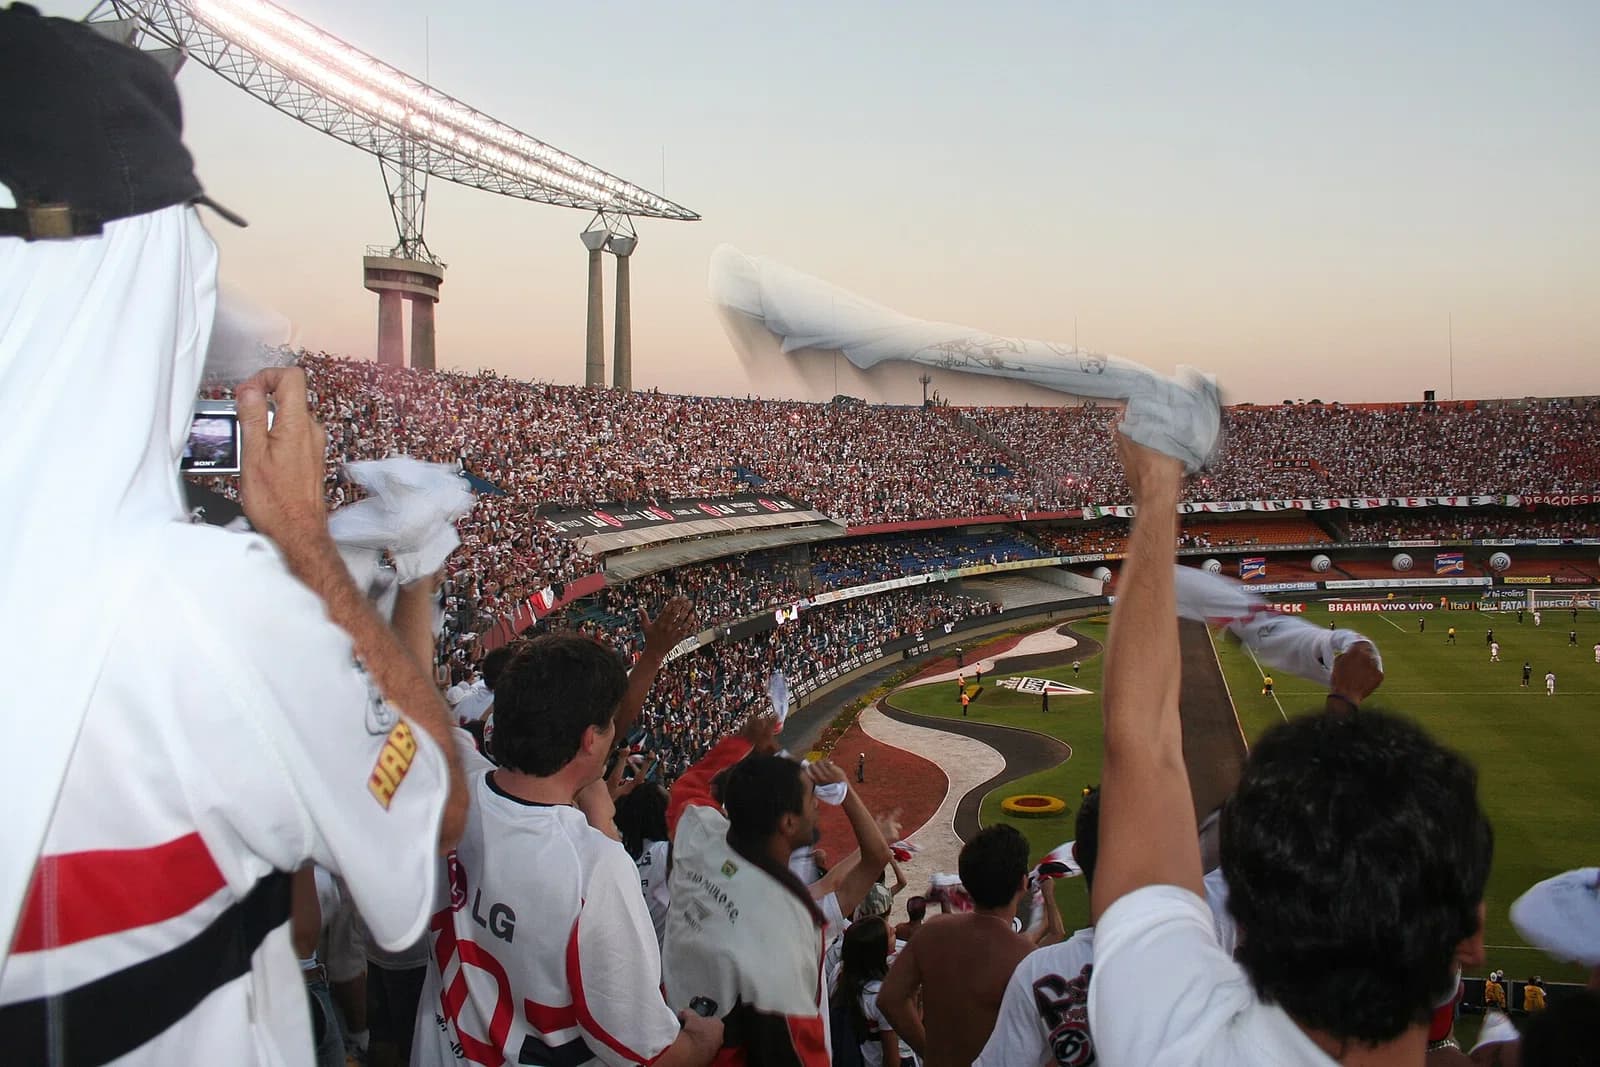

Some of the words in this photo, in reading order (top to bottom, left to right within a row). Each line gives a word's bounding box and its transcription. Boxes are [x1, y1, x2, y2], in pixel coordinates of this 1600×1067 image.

[1262, 496, 1481, 510] INDEPENDENTE
[1279, 582, 1317, 590] Dorilax
[1328, 602, 1380, 612] BRAHMA
[1380, 602, 1407, 611] VIVO
[1408, 602, 1434, 610] VIVO
[472, 888, 516, 943] LG
